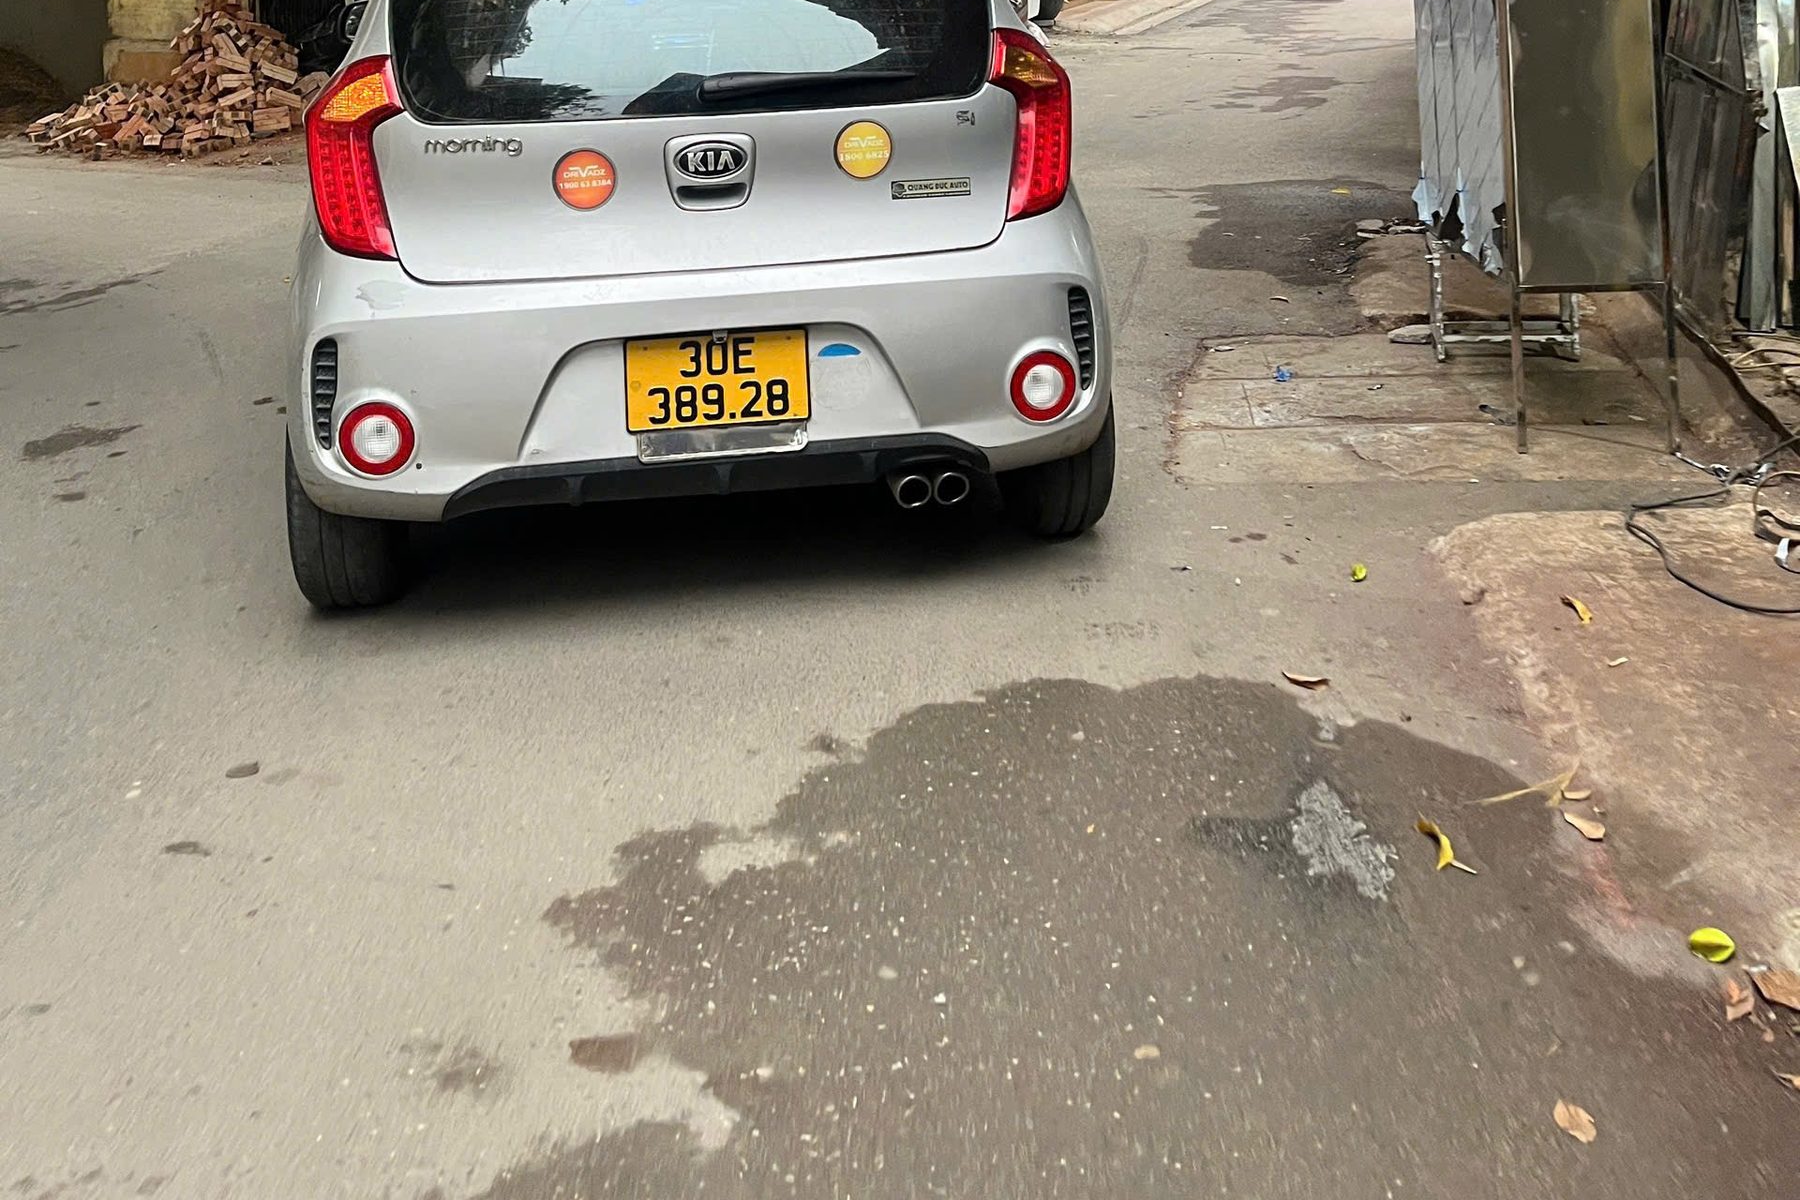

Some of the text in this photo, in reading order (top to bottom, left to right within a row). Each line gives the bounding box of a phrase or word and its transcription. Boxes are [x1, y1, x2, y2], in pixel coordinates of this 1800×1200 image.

[424, 135, 523, 157] morning
[686, 150, 737, 173] KIA
[907, 183, 934, 191] QUANG
[679, 337, 756, 378] 30E
[648, 378, 789, 425] 389.28
